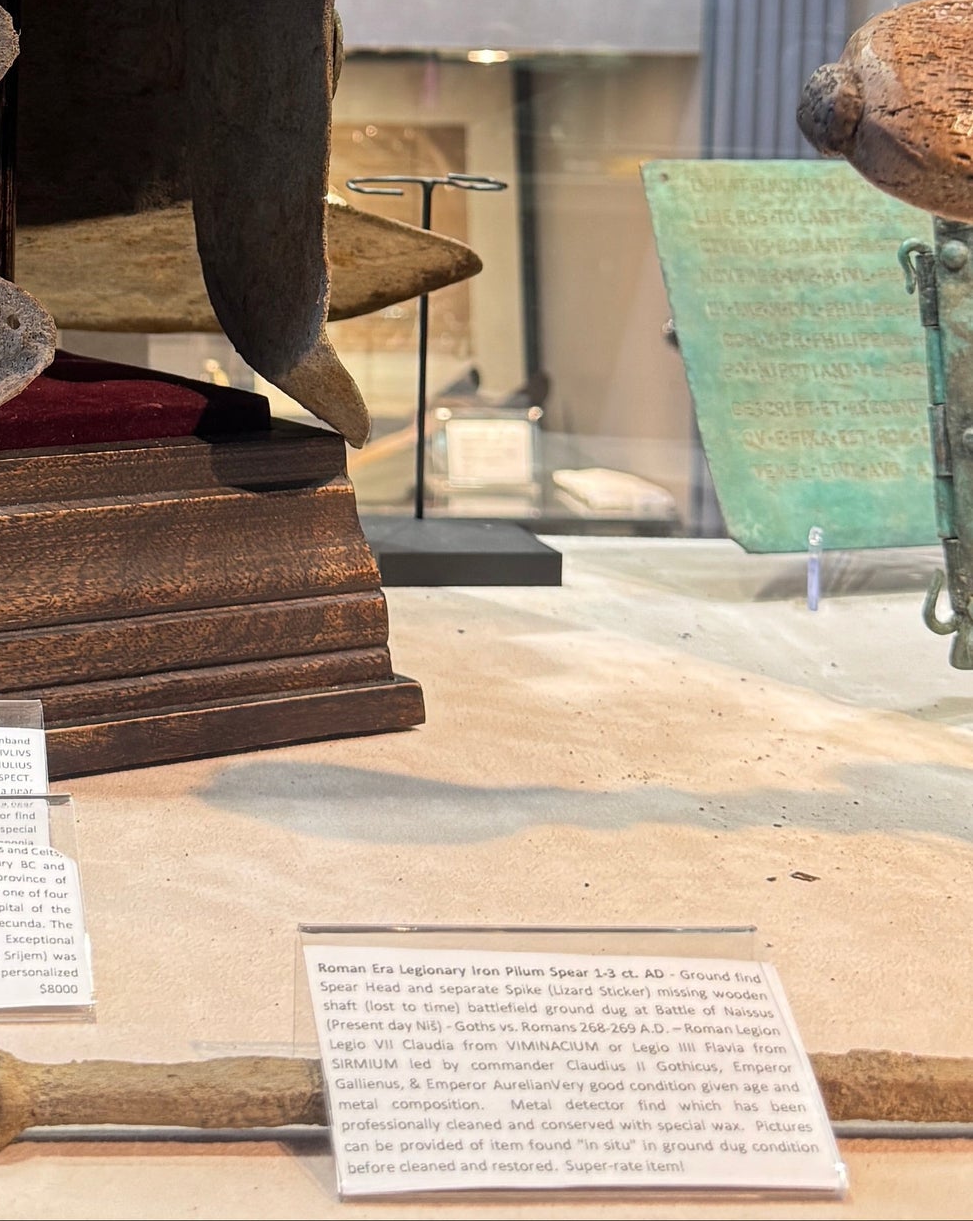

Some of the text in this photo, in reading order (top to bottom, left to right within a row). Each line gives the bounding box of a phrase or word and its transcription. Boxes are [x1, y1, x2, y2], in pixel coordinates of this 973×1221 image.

[0, 749, 31, 757] IVLIVS
[15, 812, 35, 820] find
[29, 889, 40, 897] of
[44, 890, 68, 898] four
[50, 920, 73, 929] The
[6, 934, 74, 945] Exceptional
[4, 951, 47, 962] Srijem)
[318, 963, 366, 973] Roman
[372, 964, 394, 974] Era
[400, 965, 466, 977] Legionary
[472, 966, 500, 976] Iron
[549, 967, 588, 979] Spear
[594, 968, 616, 978] 1-3
[622, 970, 638, 978] ct.
[645, 969, 664, 978] AD
[680, 970, 730, 981] Ground
[735, 972, 761, 984] find
[40, 984, 78, 994] $8000
[320, 981, 767, 1000] Spear Head and separate Spike (Lizard Sticker) missing wooden
[324, 1000, 774, 1018] shaft (lost to time) battlefield ground dug at Battle of Naissus
[327, 1019, 383, 1032] (Present
[388, 1020, 412, 1033] day
[455, 1021, 496, 1032] Goths
[499, 1024, 518, 1032] vs.
[521, 1022, 577, 1032] Romans
[580, 1022, 636, 1033] 268-269
[684, 1023, 733, 1034] Roman
[736, 1025, 780, 1038] Legion
[330, 1039, 366, 1052] Legio
[374, 1039, 393, 1049] VII
[403, 1039, 454, 1051] Claudia
[463, 1040, 497, 1051] from
[506, 1041, 599, 1051] VIMINACIUM
[609, 1044, 622, 1053] or
[632, 1042, 670, 1055] Legio
[705, 1042, 744, 1053] Flavia
[753, 1043, 786, 1054] from
[332, 1058, 791, 1074] SIRMIUM led by commander Claudius II Gothicus, Emperor
[342, 1118, 440, 1133] professionally
[446, 1119, 502, 1130] cleaned
[508, 1119, 535, 1130] and
[541, 1119, 614, 1130] conserved
[619, 1119, 652, 1130] with
[658, 1120, 706, 1133] special
[756, 1120, 813, 1133] Pictures
